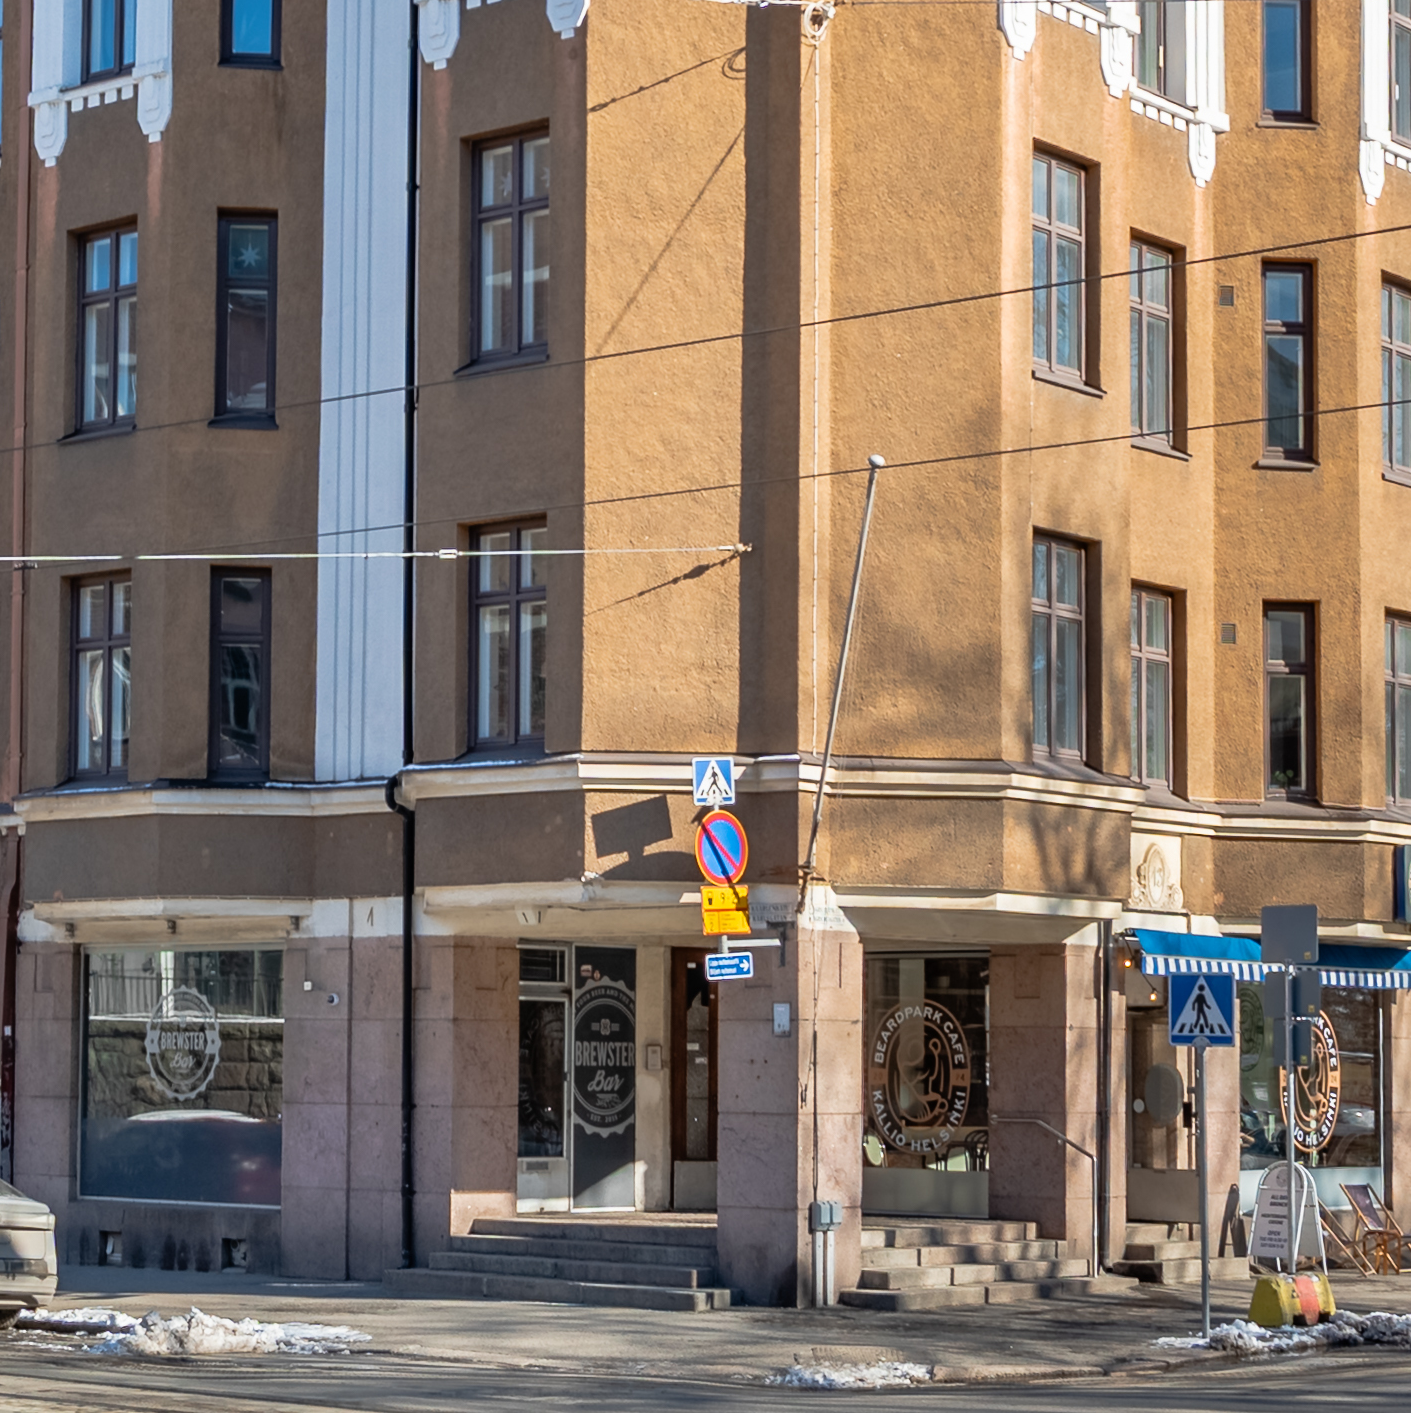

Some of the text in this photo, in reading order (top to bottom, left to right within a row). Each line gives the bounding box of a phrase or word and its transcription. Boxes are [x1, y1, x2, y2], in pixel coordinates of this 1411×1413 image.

[367, 906, 374, 927] 1
[160, 1031, 205, 1050] BREWSTER
[874, 1005, 965, 1065] BEARDPARK CAFE
[1323, 1027, 1338, 1068] CAFE
[170, 1051, 196, 1068] Bar
[574, 1040, 635, 1067] BREWSTER
[587, 1069, 625, 1092] Bar
[873, 1090, 966, 1152] KALLIO HELSINKI
[1305, 1092, 1337, 1146] HELSINKI
